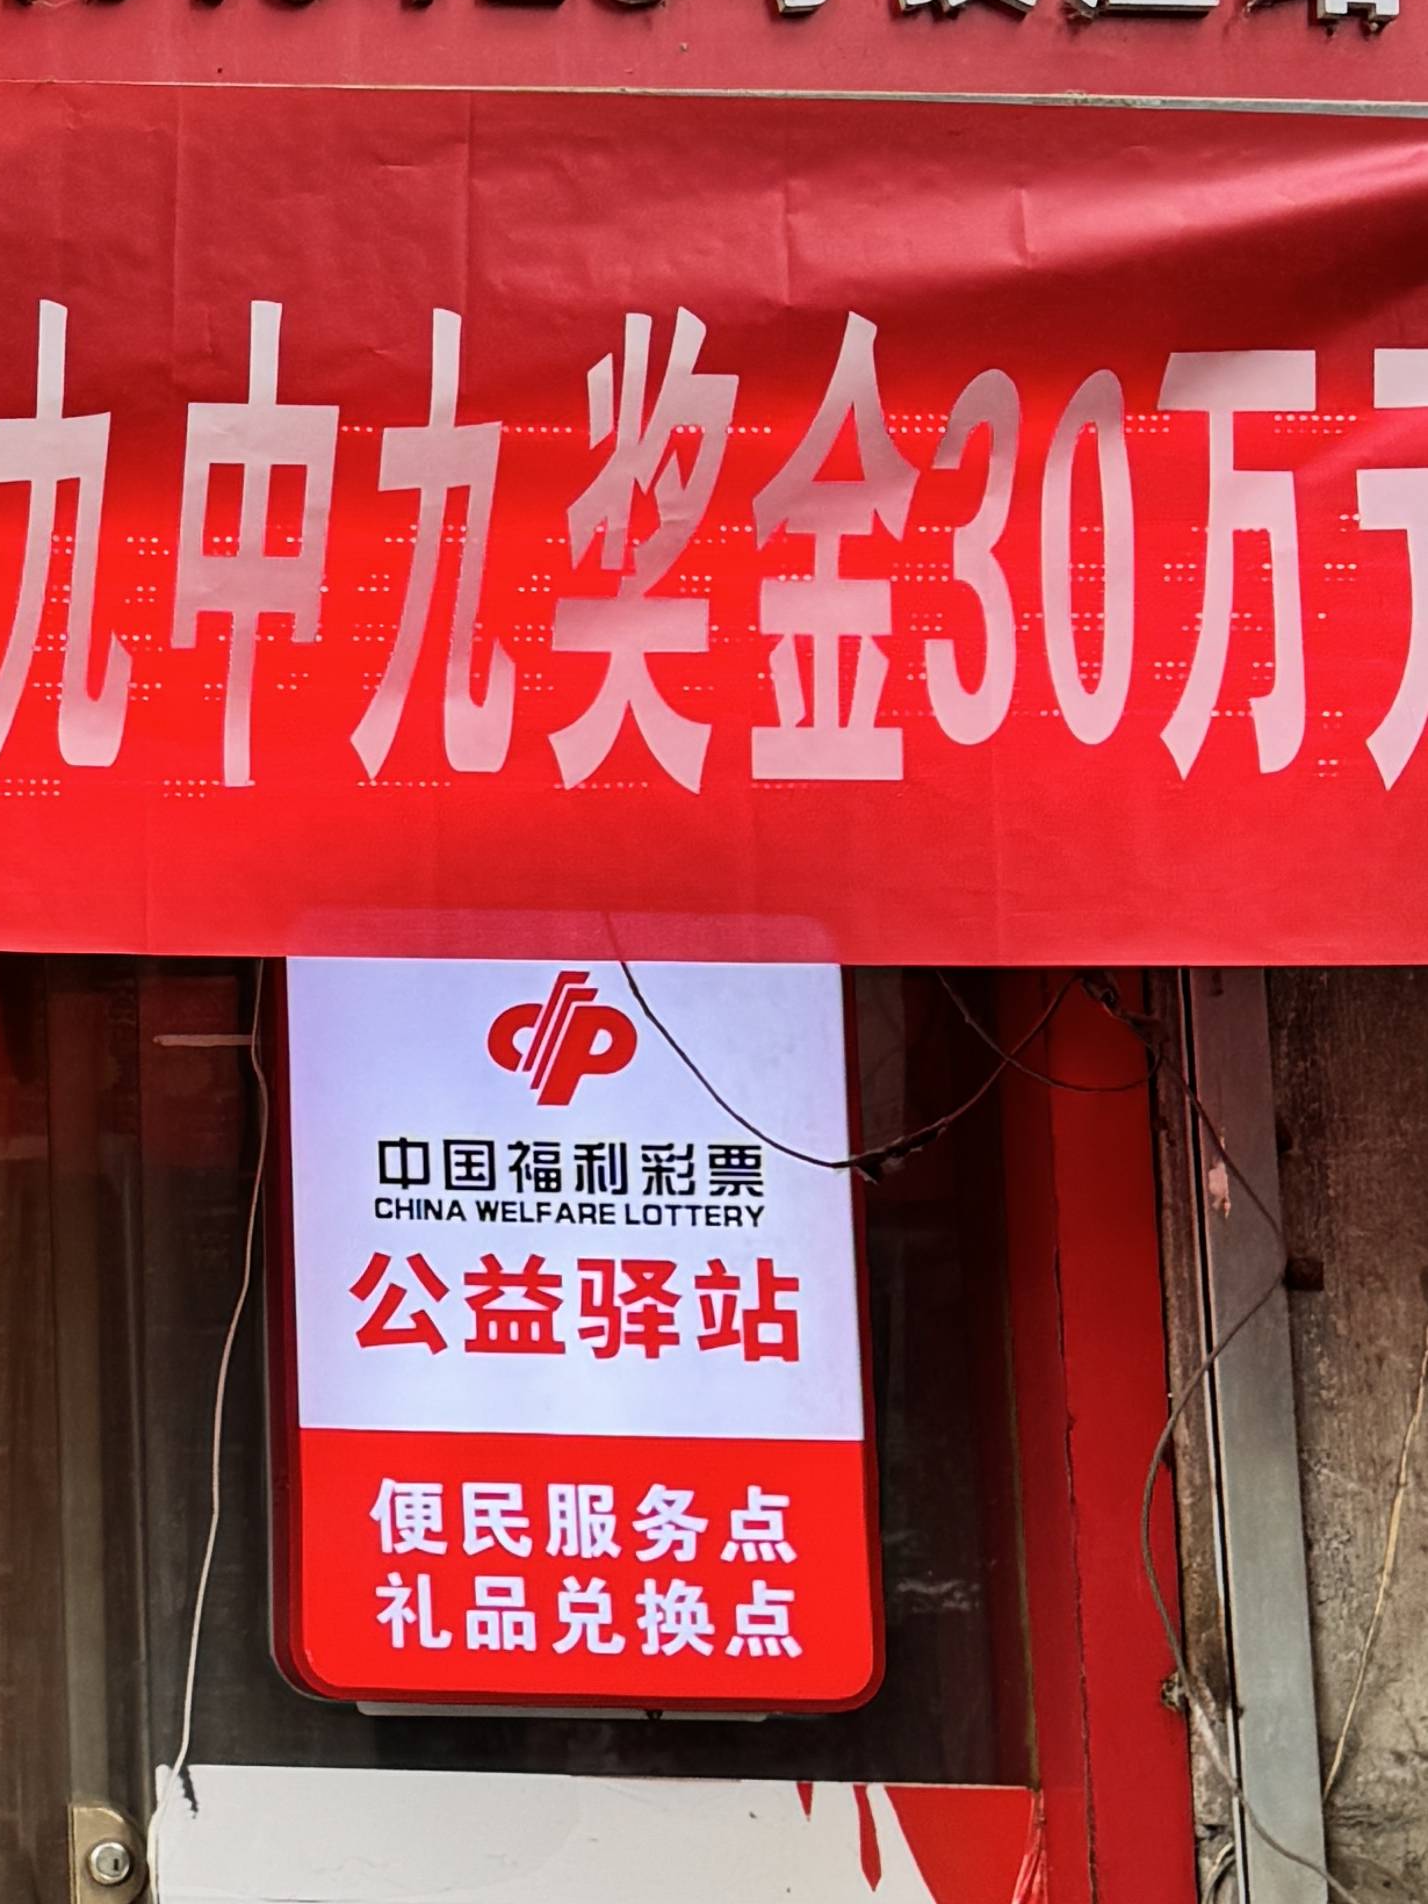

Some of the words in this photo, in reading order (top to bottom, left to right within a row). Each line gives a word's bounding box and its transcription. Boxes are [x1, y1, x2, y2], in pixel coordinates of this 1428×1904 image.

[378, 1137, 765, 1198] 中国福利彩票
[374, 1198, 466, 1223] CHINA
[476, 1200, 616, 1226] WELFARE
[625, 1202, 765, 1229] LOTTERY
[349, 1251, 801, 1363] 公益驿站
[370, 1476, 798, 1564] 便民服务点
[375, 1573, 802, 1660] 礼品兑换点
